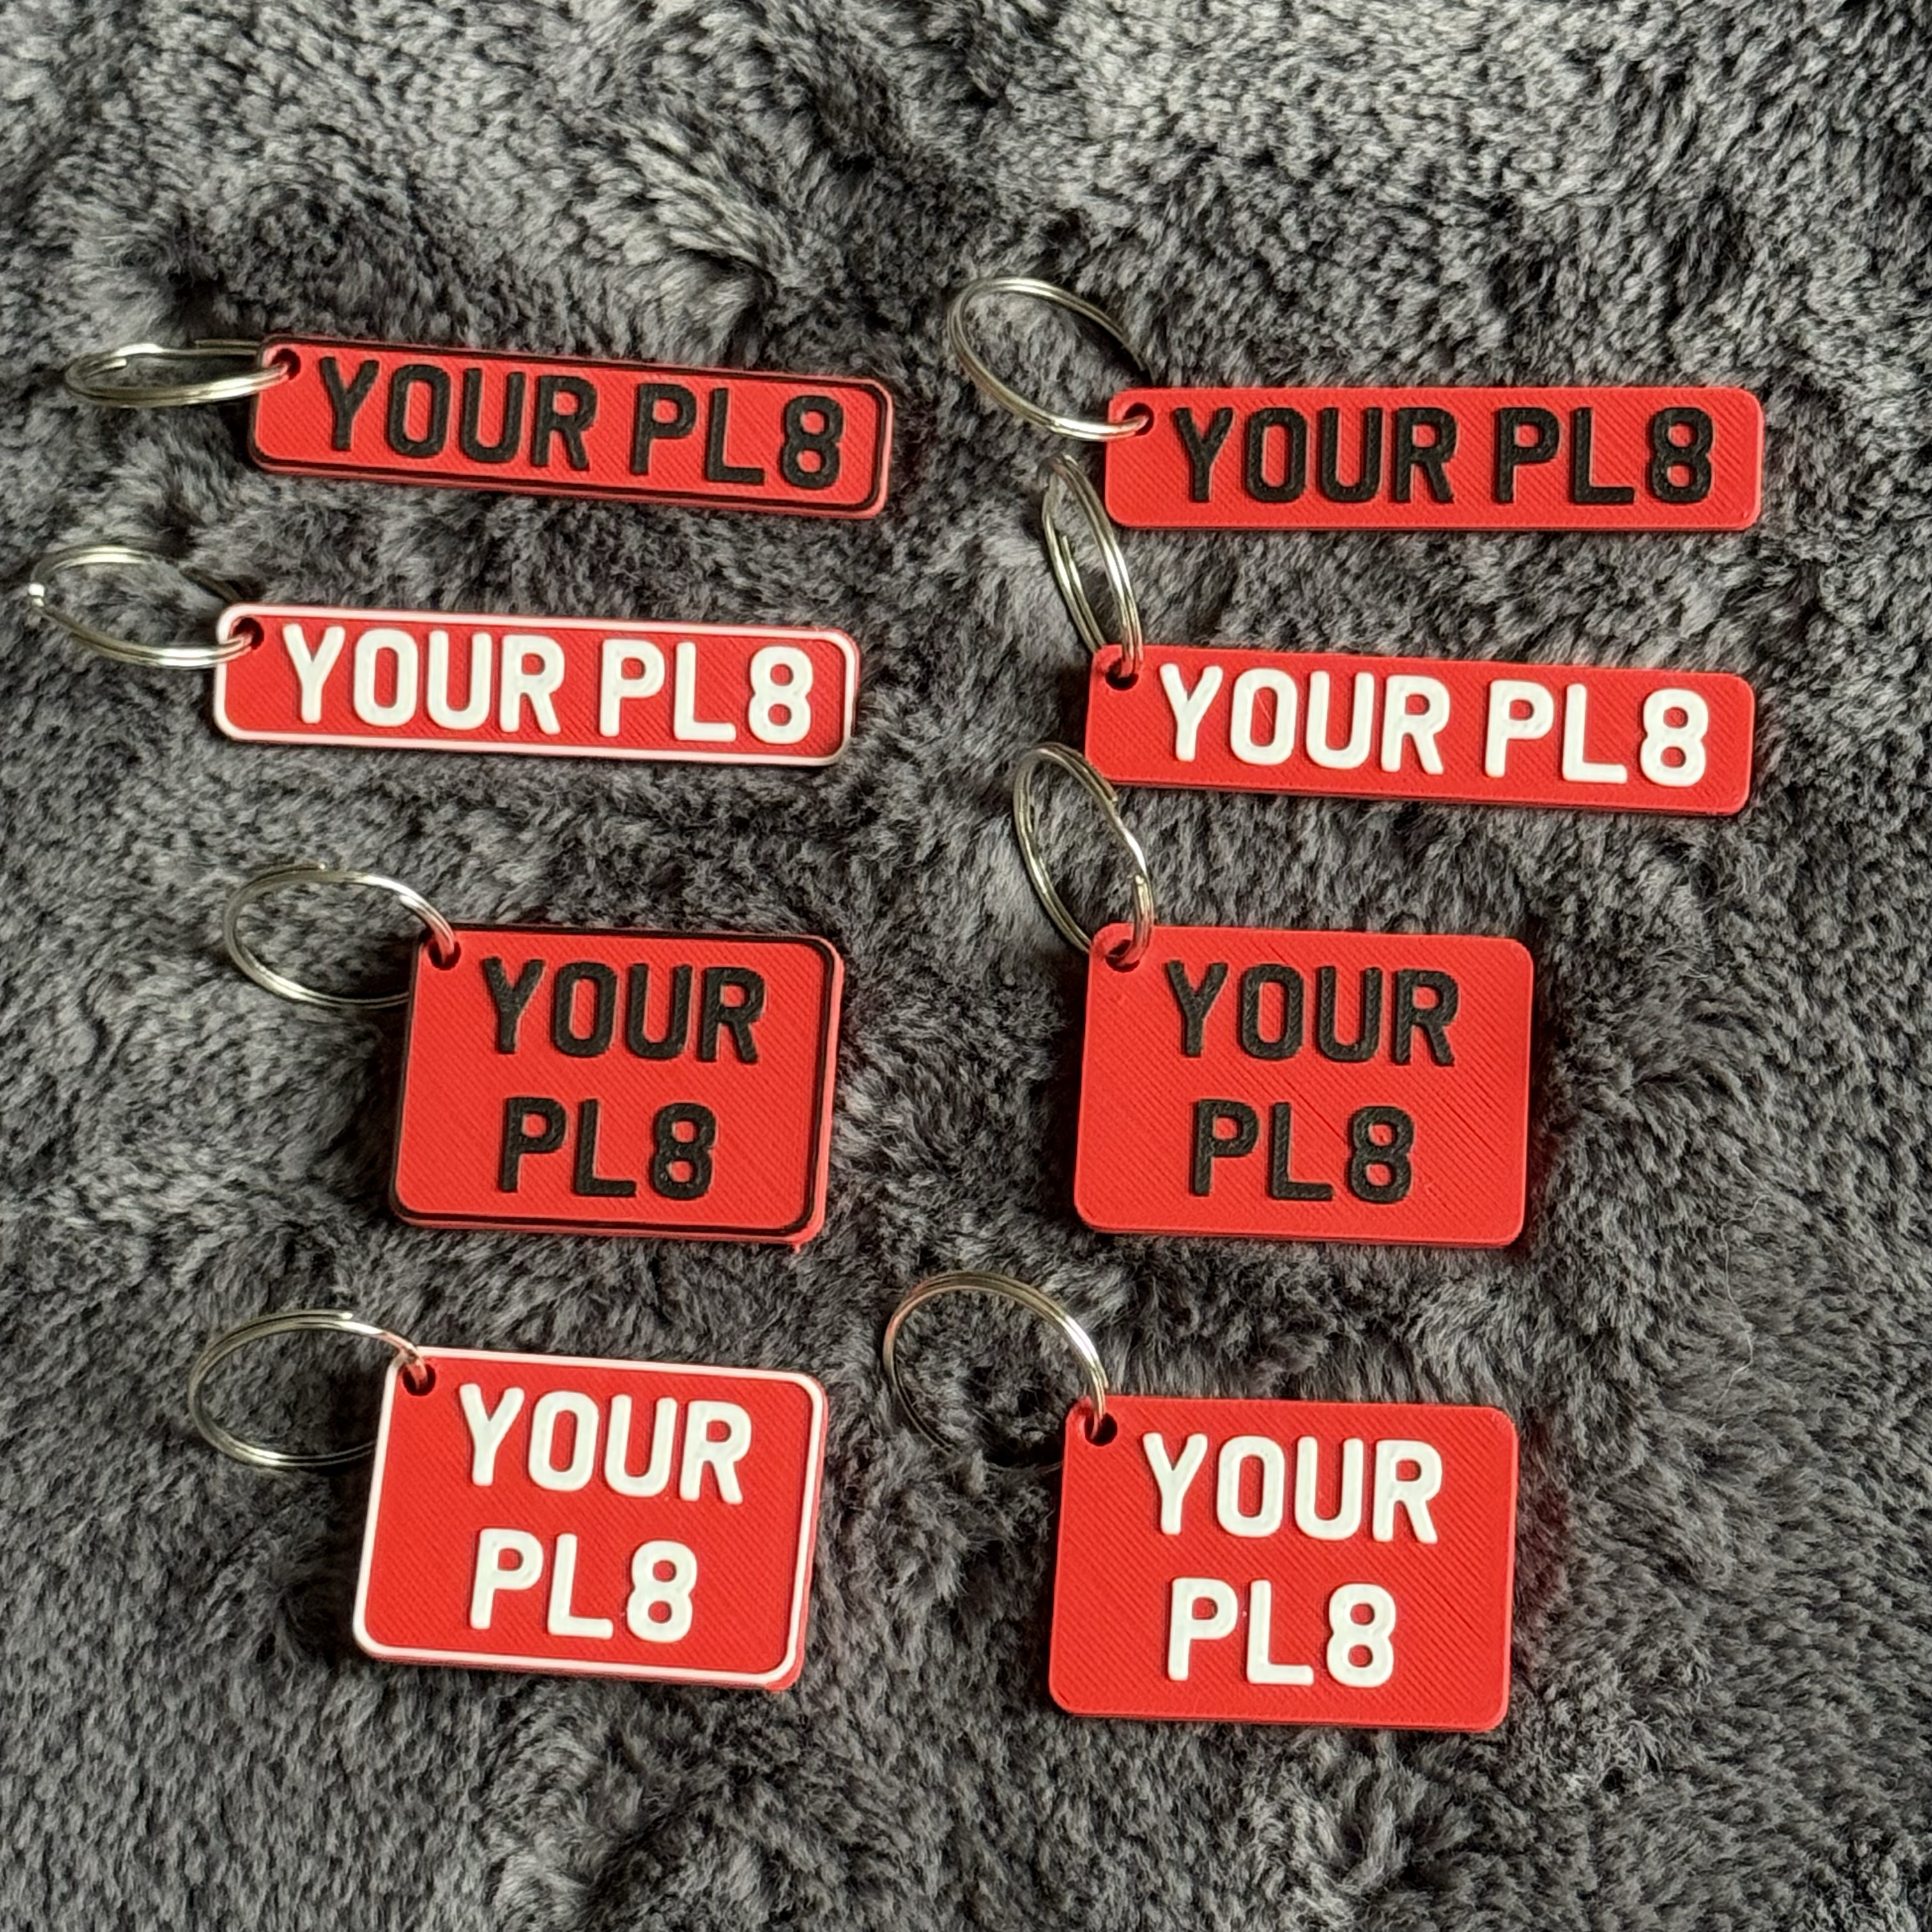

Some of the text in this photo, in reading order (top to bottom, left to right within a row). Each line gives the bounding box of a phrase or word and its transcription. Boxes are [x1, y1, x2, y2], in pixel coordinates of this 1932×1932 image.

[318, 356, 844, 491] YOUR PL8
[1171, 406, 1714, 506] YOUR PL8
[282, 622, 815, 745] YOUR PL8
[1159, 662, 1710, 788] YOUR PL8
[480, 956, 765, 1064] YOUR
[1164, 960, 1459, 1067] YOUR
[496, 1096, 717, 1201] PL8
[1188, 1098, 1414, 1205] PL8
[459, 1382, 753, 1505] YOUR
[1142, 1431, 1444, 1545] YOUR
[470, 1527, 699, 1644] PL8
[1167, 1576, 1398, 1689] PL8
